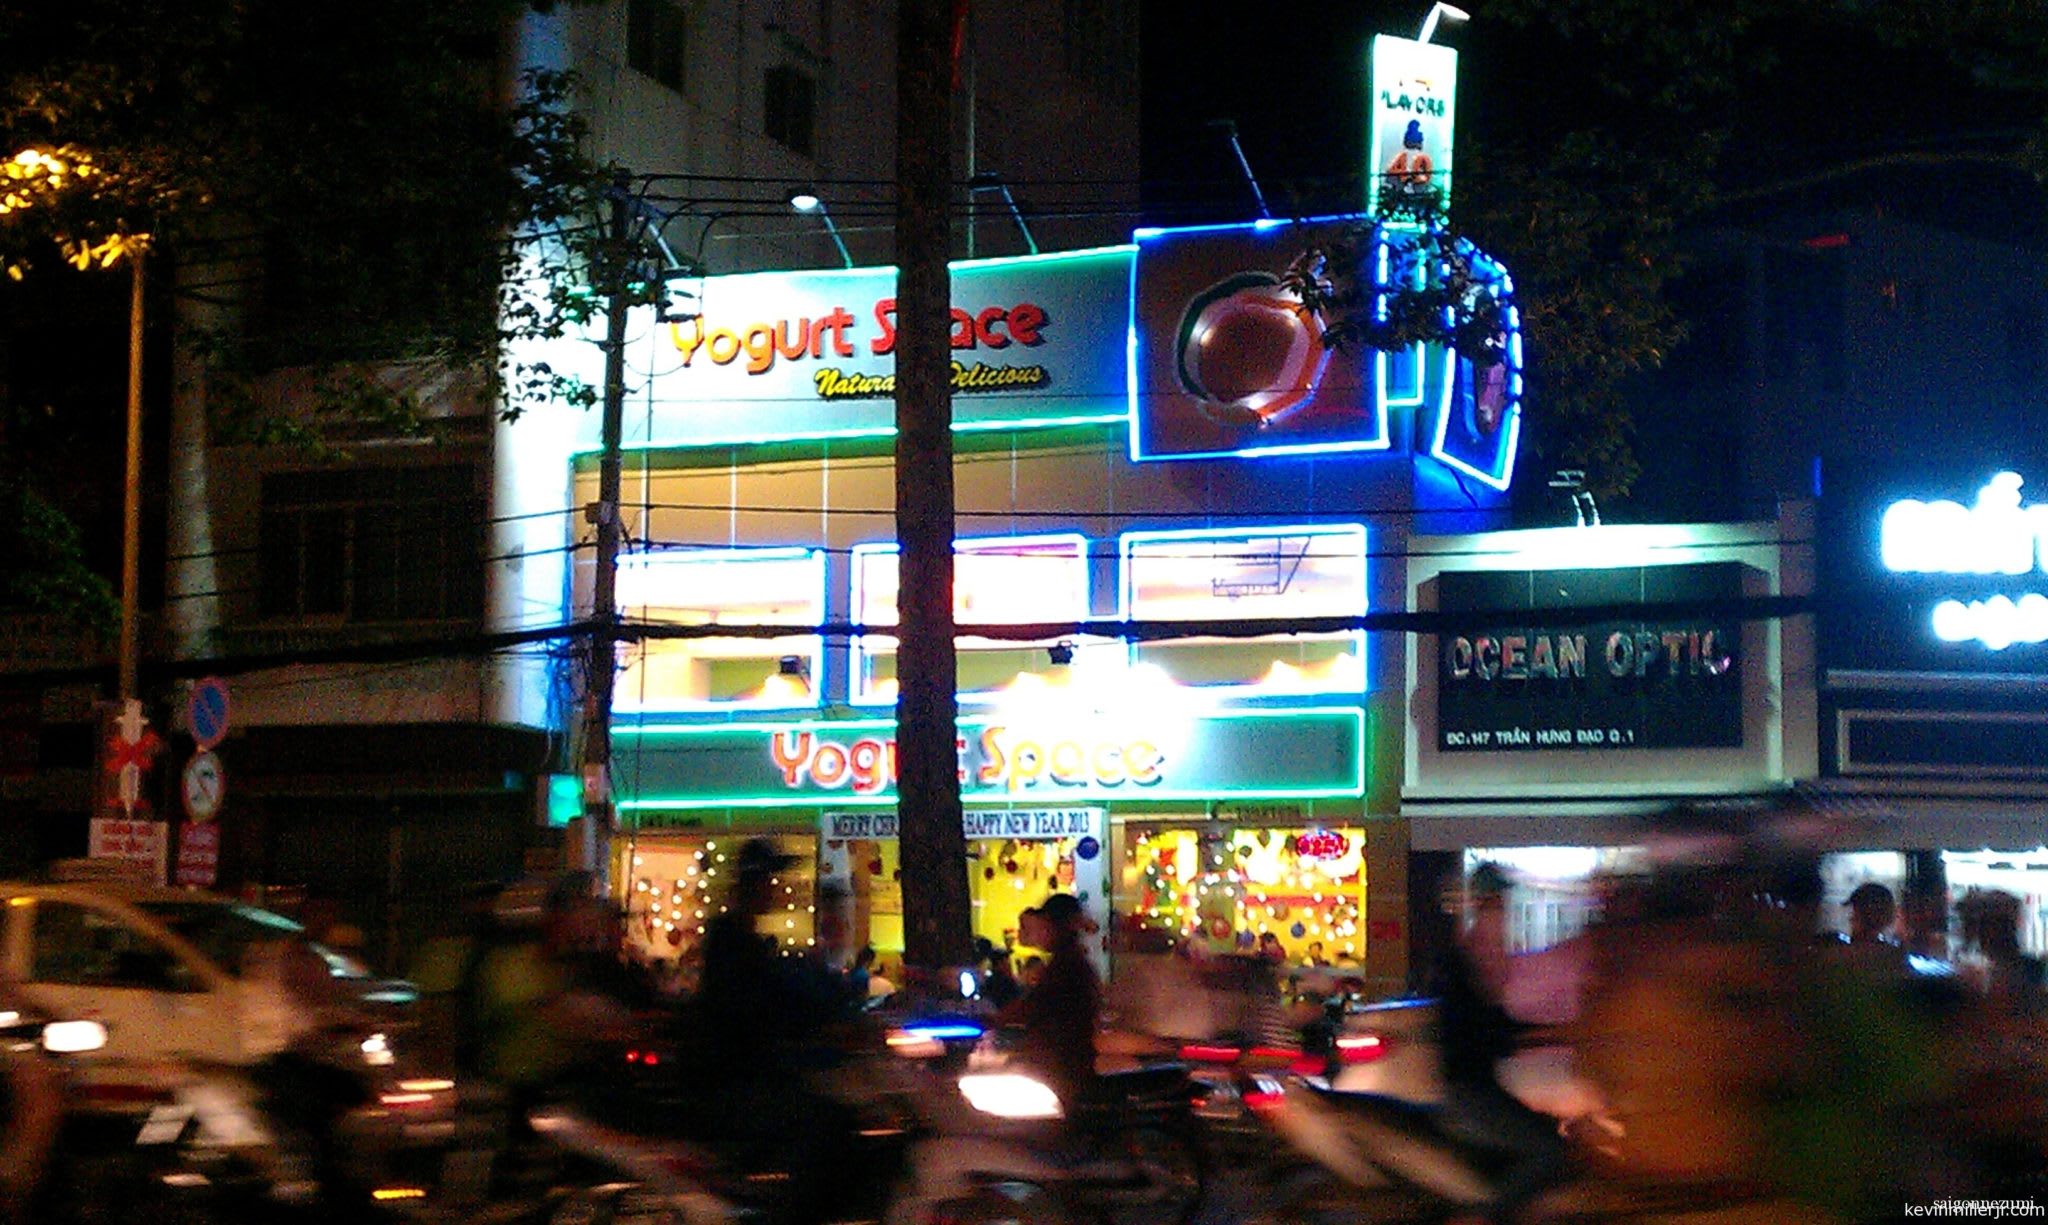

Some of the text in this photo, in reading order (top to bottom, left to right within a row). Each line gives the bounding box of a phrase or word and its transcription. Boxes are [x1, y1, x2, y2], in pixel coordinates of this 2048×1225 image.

[671, 298, 1045, 375] Yogurt Sace
[815, 367, 896, 396] Natura
[1451, 629, 1732, 680] OCEAN OPTIC
[979, 726, 1160, 792] Space
[833, 815, 872, 837] MERRY
[965, 813, 1002, 834] HAPPY
[1005, 812, 1030, 834] NEW
[1033, 811, 1065, 834] YEAR
